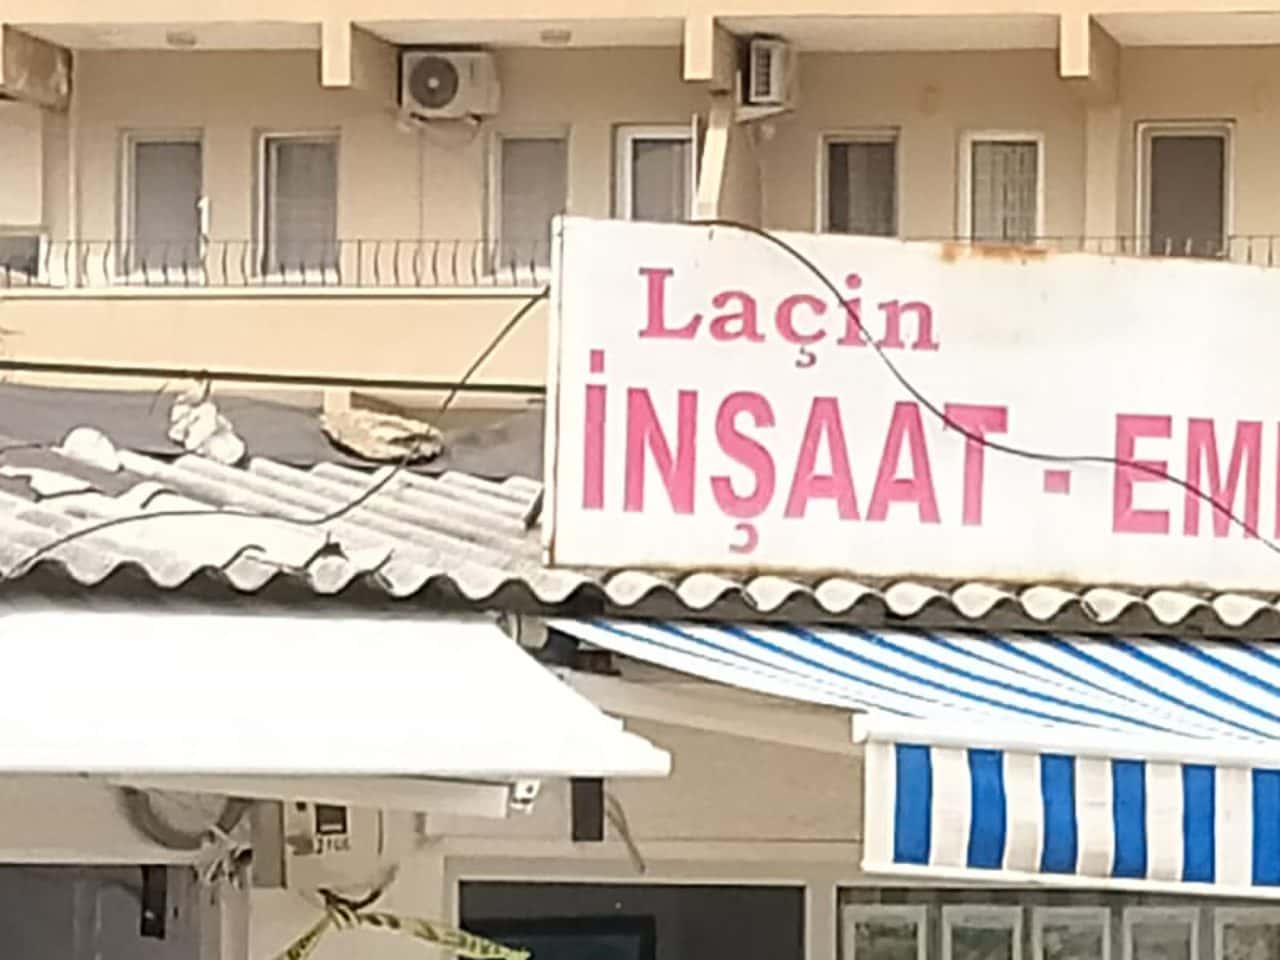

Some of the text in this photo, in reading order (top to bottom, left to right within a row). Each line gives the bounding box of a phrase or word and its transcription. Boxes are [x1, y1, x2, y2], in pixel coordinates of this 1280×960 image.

[638, 267, 940, 368] Laçin
[582, 349, 1009, 555] İNŞAAT
[1043, 469, 1071, 495] -
